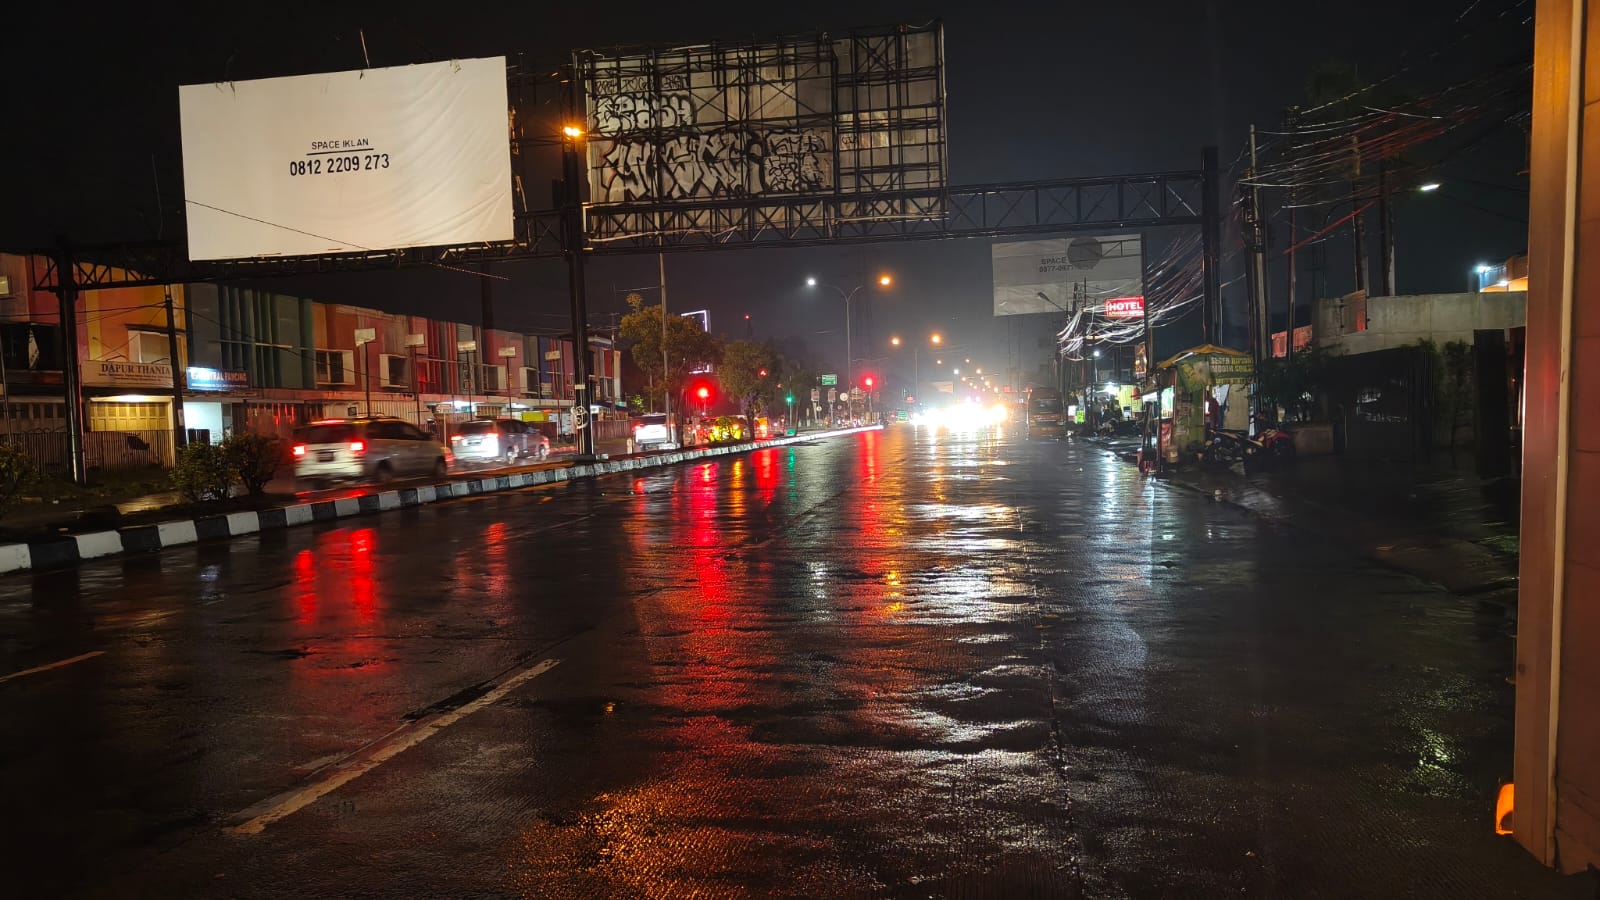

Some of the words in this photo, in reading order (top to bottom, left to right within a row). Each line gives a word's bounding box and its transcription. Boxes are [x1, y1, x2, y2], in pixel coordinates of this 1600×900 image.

[311, 140, 340, 150] SPACE
[342, 138, 369, 148] IKLAN
[290, 159, 321, 176] 0812
[327, 155, 360, 173] 2209
[364, 153, 390, 170] 273
[1109, 301, 1143, 311] HOTEL
[101, 363, 134, 374] DAPUR
[136, 364, 171, 375] THANIA
